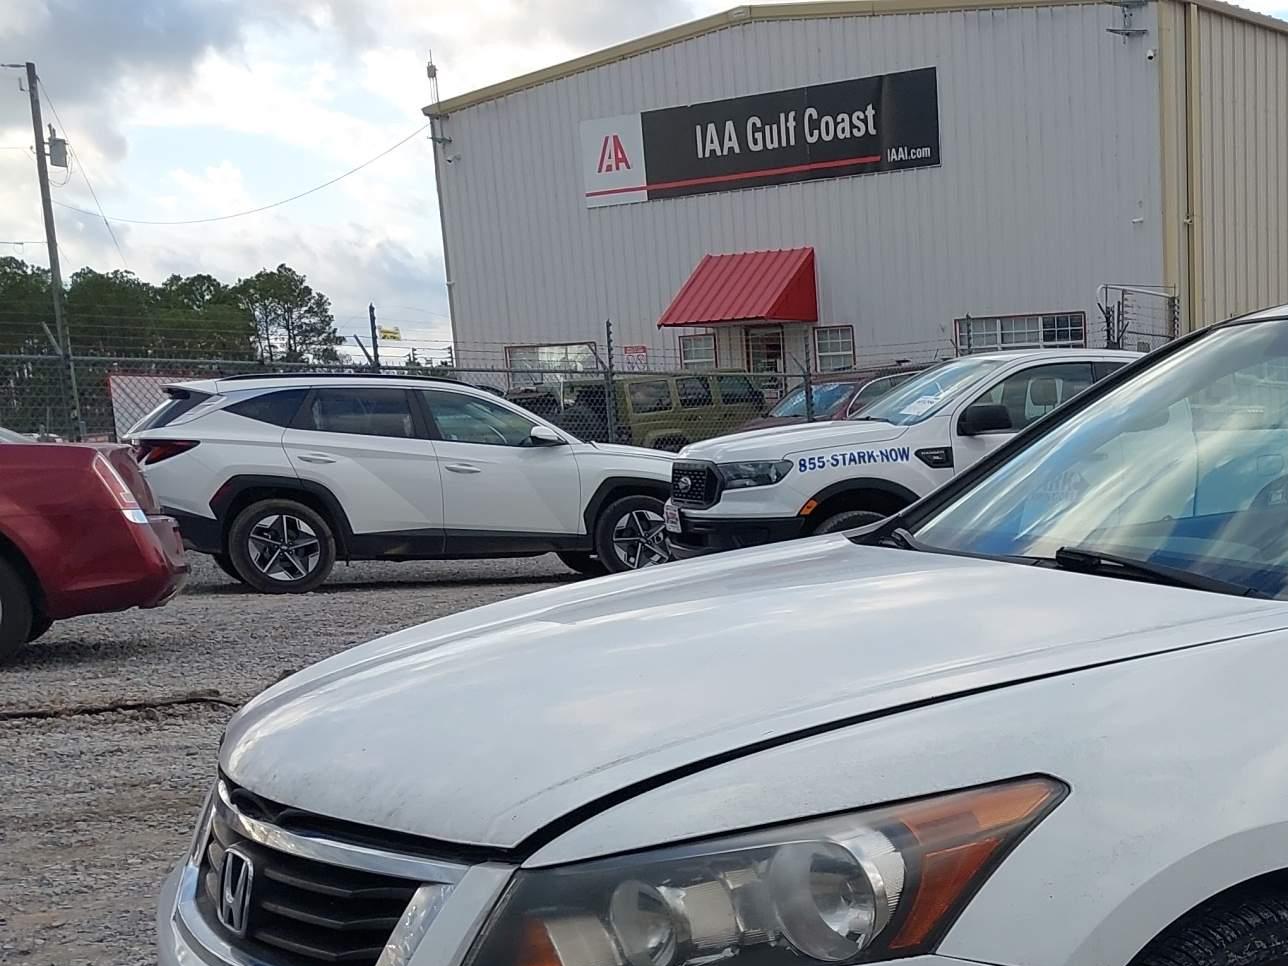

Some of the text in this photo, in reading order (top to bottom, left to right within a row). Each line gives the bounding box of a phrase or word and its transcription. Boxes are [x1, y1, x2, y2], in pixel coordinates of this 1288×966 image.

[696, 103, 877, 158] IAA Gulf Coast
[887, 146, 931, 162] IAAI.com
[798, 447, 910, 473] 855-STARK-NOW
